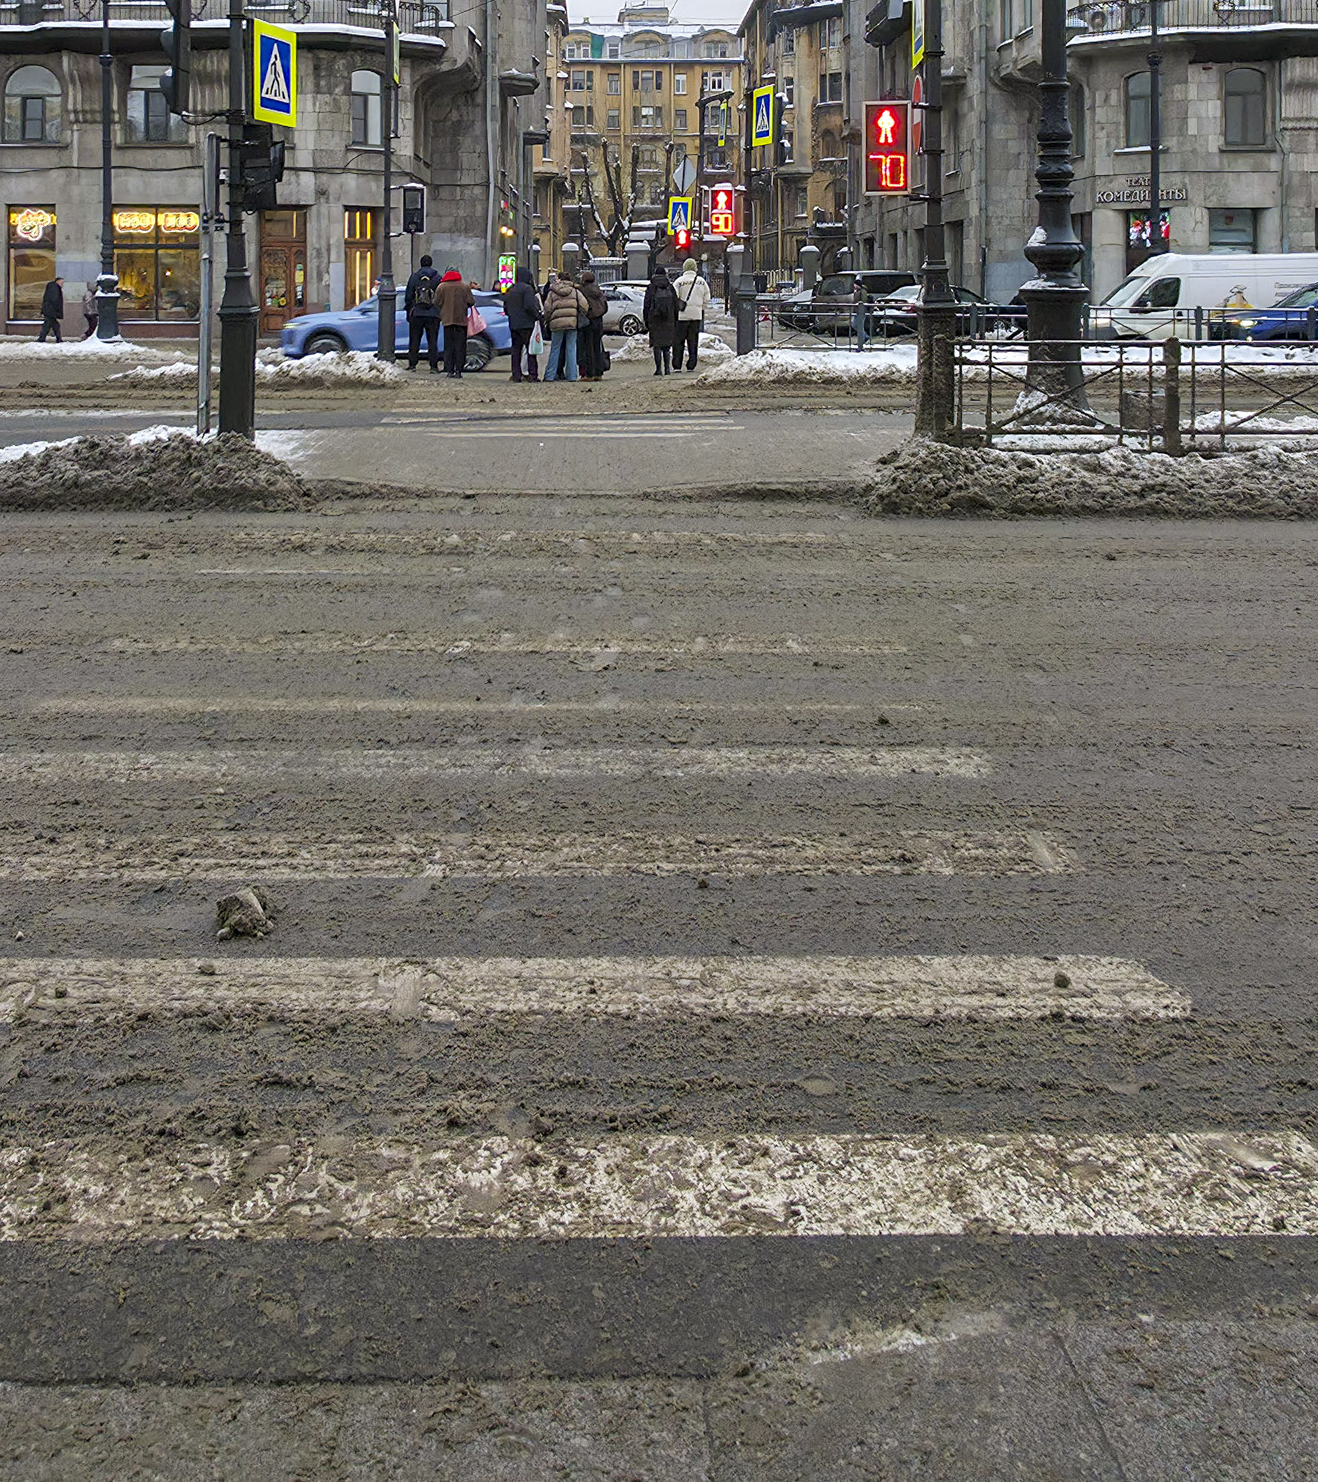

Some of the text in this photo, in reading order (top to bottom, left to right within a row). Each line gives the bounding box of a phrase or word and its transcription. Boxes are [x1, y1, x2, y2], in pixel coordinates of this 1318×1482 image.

[869, 155, 905, 187] 70
[1126, 178, 1154, 186] ТЕАТ
[1096, 189, 1187, 202] КОМЕДИНТЫ
[712, 213, 733, 233] 90
